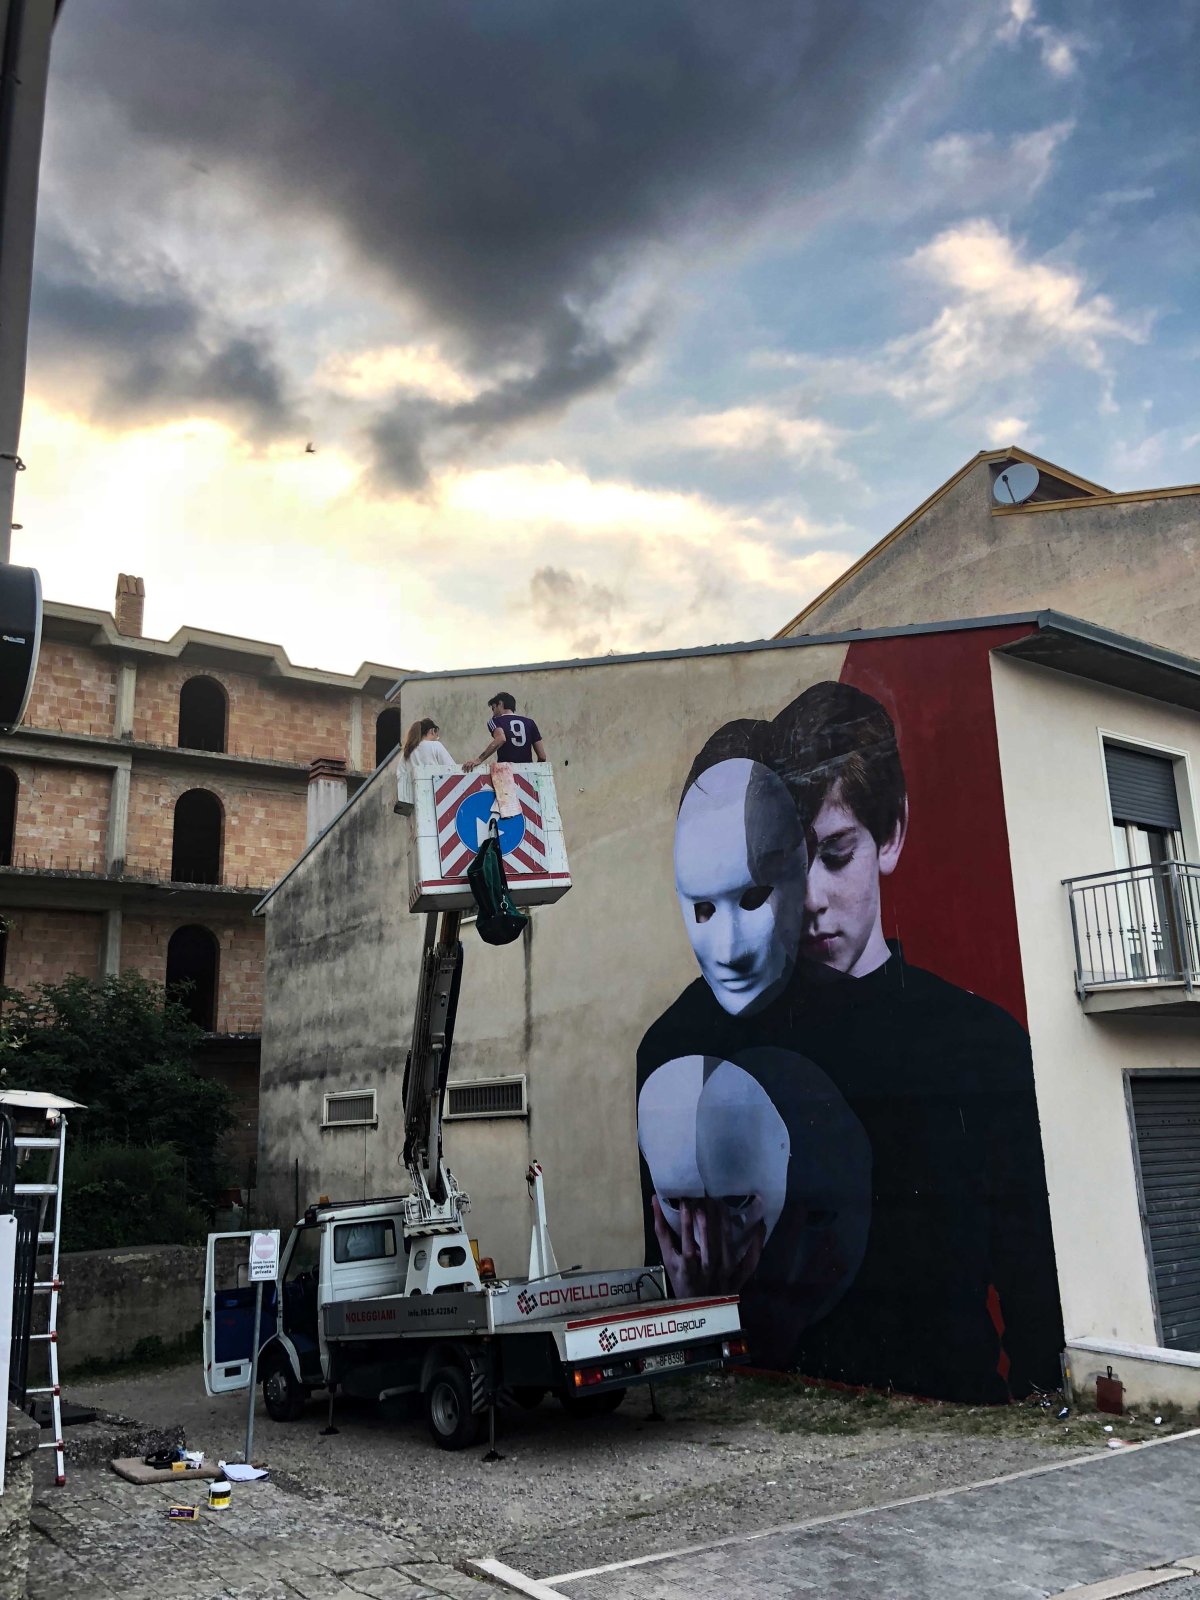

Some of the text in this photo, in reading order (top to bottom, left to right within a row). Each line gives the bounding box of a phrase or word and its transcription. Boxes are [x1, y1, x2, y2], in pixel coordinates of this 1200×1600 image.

[510, 719, 527, 747] 9
[539, 1281, 645, 1307] COVIELLO GROUP
[345, 1309, 396, 1323] NOLEGGIAMI
[619, 1318, 707, 1342] COVIELLO GROUP
